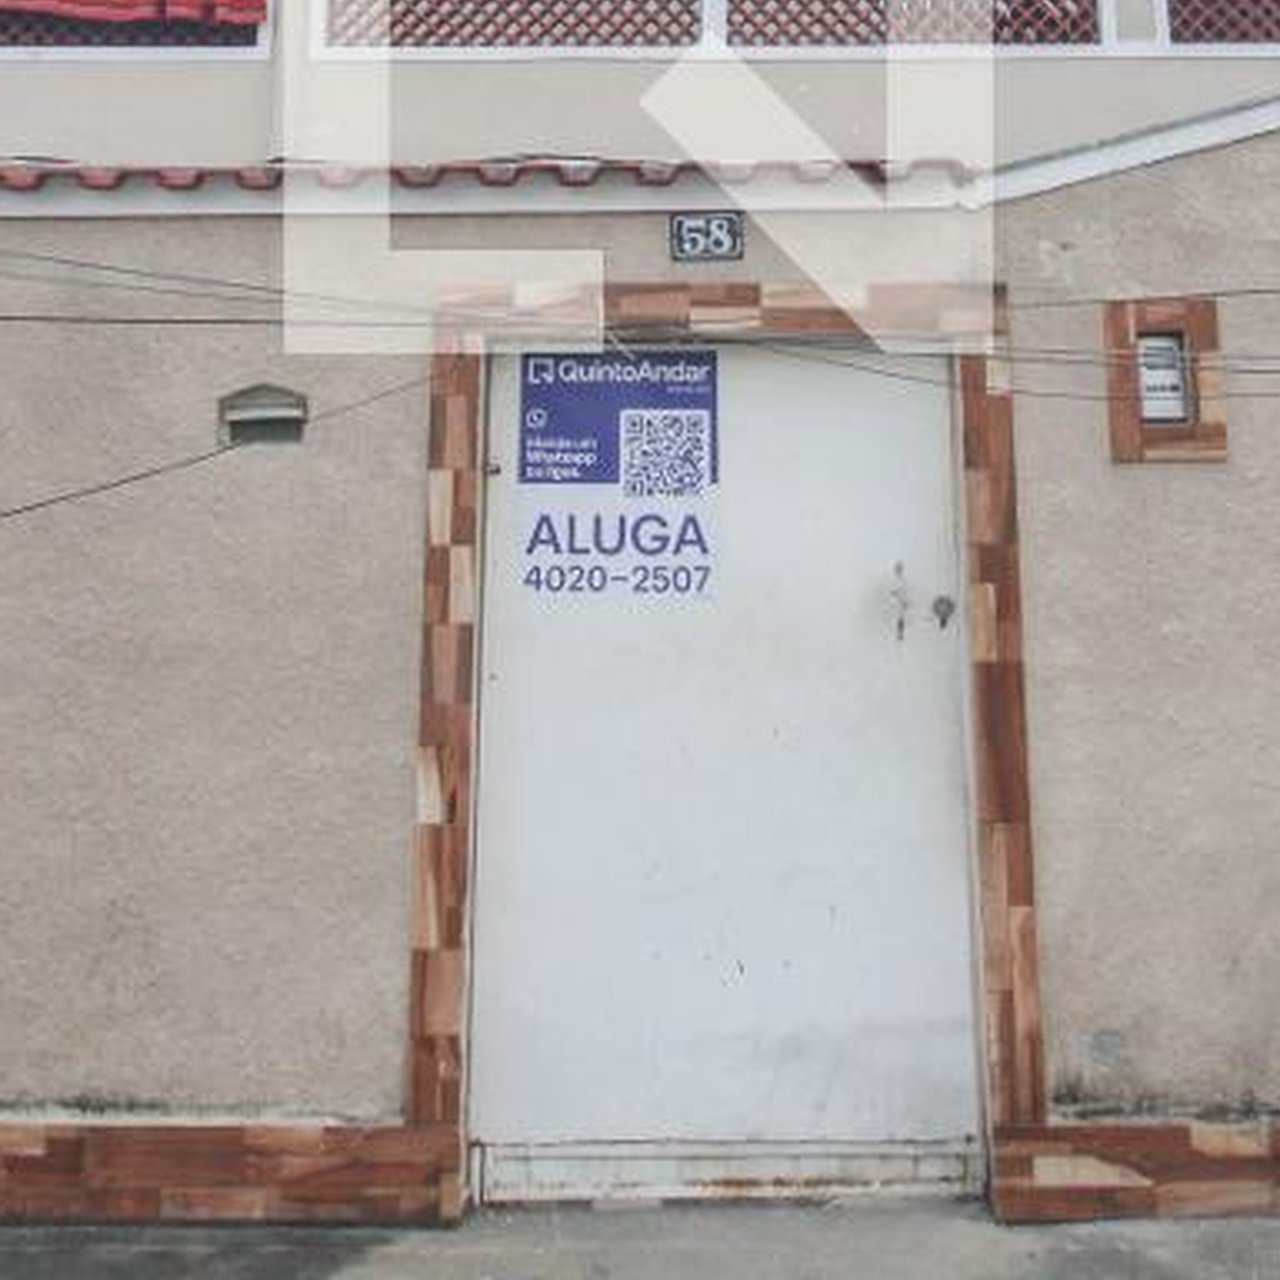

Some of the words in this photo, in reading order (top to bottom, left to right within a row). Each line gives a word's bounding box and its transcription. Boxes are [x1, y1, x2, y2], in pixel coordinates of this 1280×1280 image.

[681, 218, 733, 254] 58
[557, 357, 712, 384] QuintoAndar
[526, 515, 709, 556] ALUGA
[524, 565, 711, 594] 4020-2507
